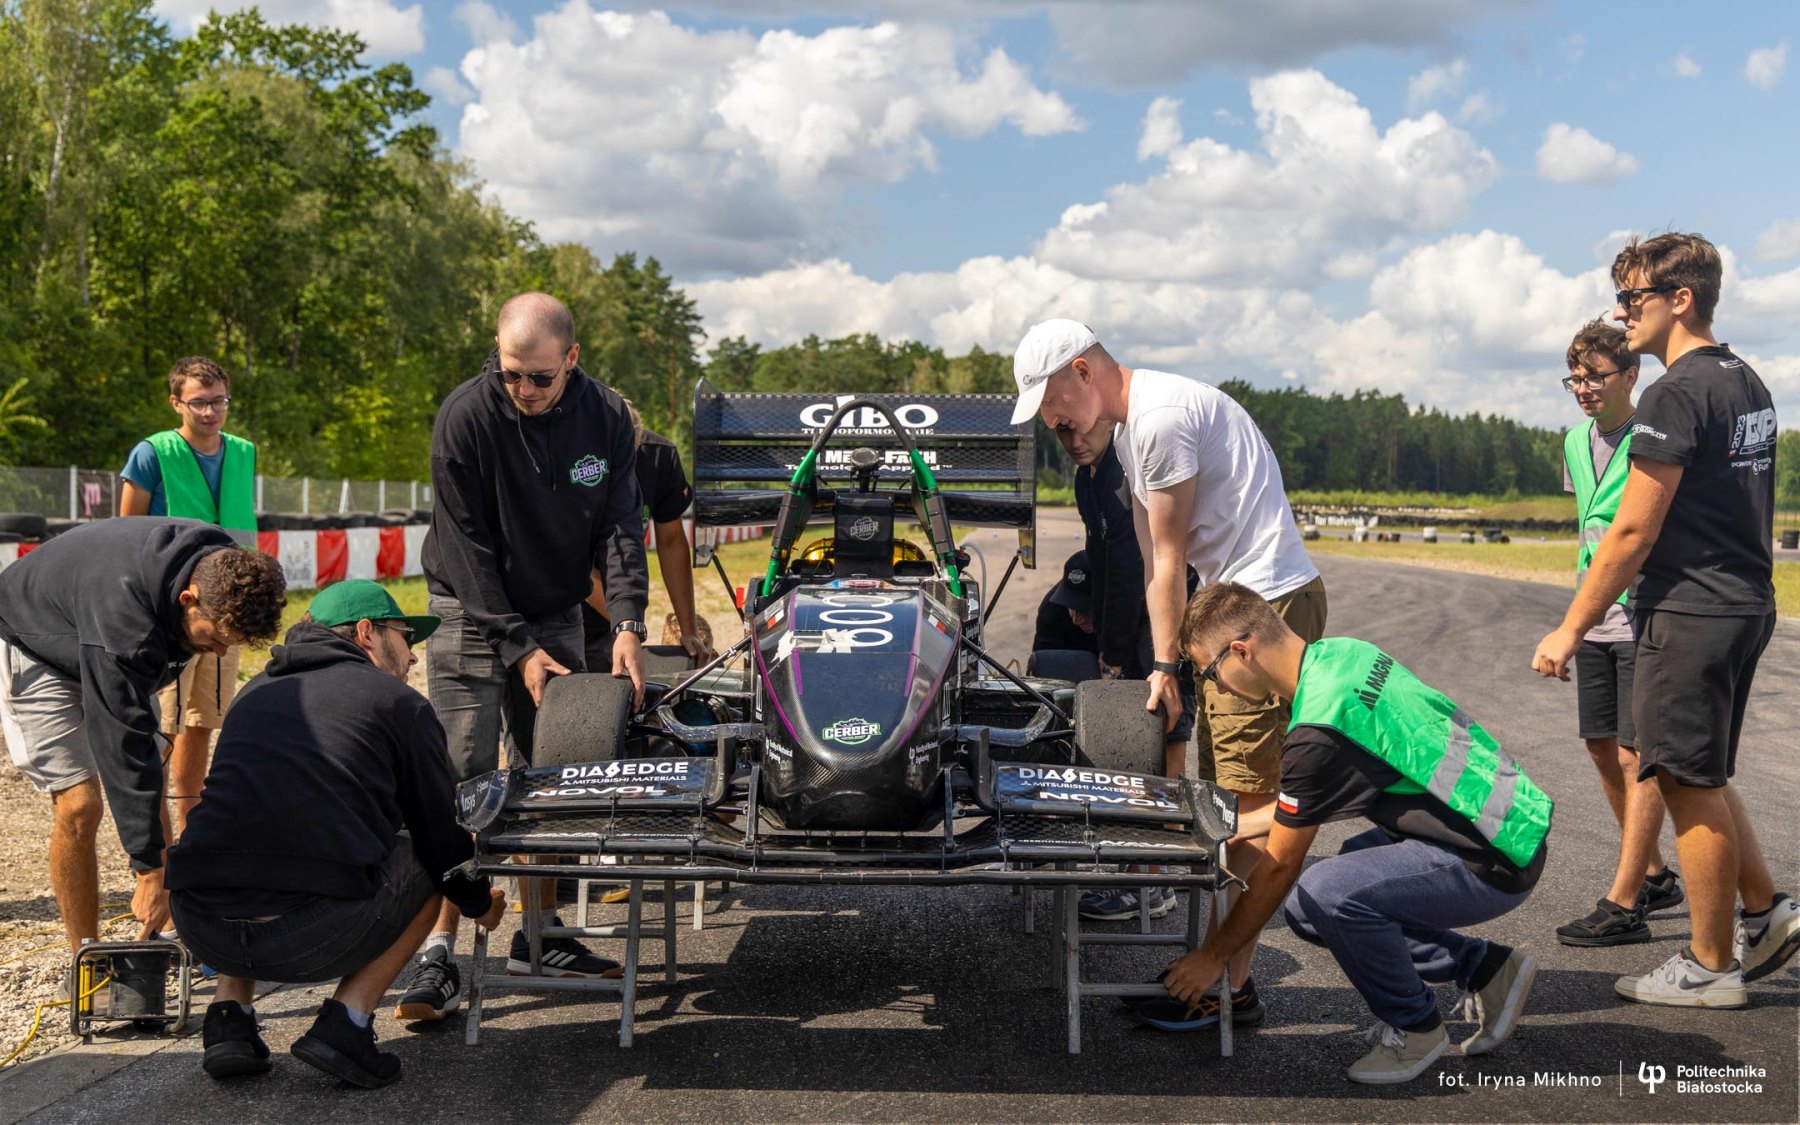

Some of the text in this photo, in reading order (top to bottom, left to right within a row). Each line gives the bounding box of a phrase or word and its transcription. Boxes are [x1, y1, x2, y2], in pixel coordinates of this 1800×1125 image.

[1731, 414, 1746, 449] 2023
[571, 460, 606, 481] CERBER
[825, 724, 878, 739] CERBER
[572, 775, 687, 785] MITSUBISHI MATERIALS
[528, 786, 666, 797] NOVOL
[1033, 782, 1146, 795] MITSUBISHI MATERIALS
[1040, 792, 1180, 809] NOVOL
